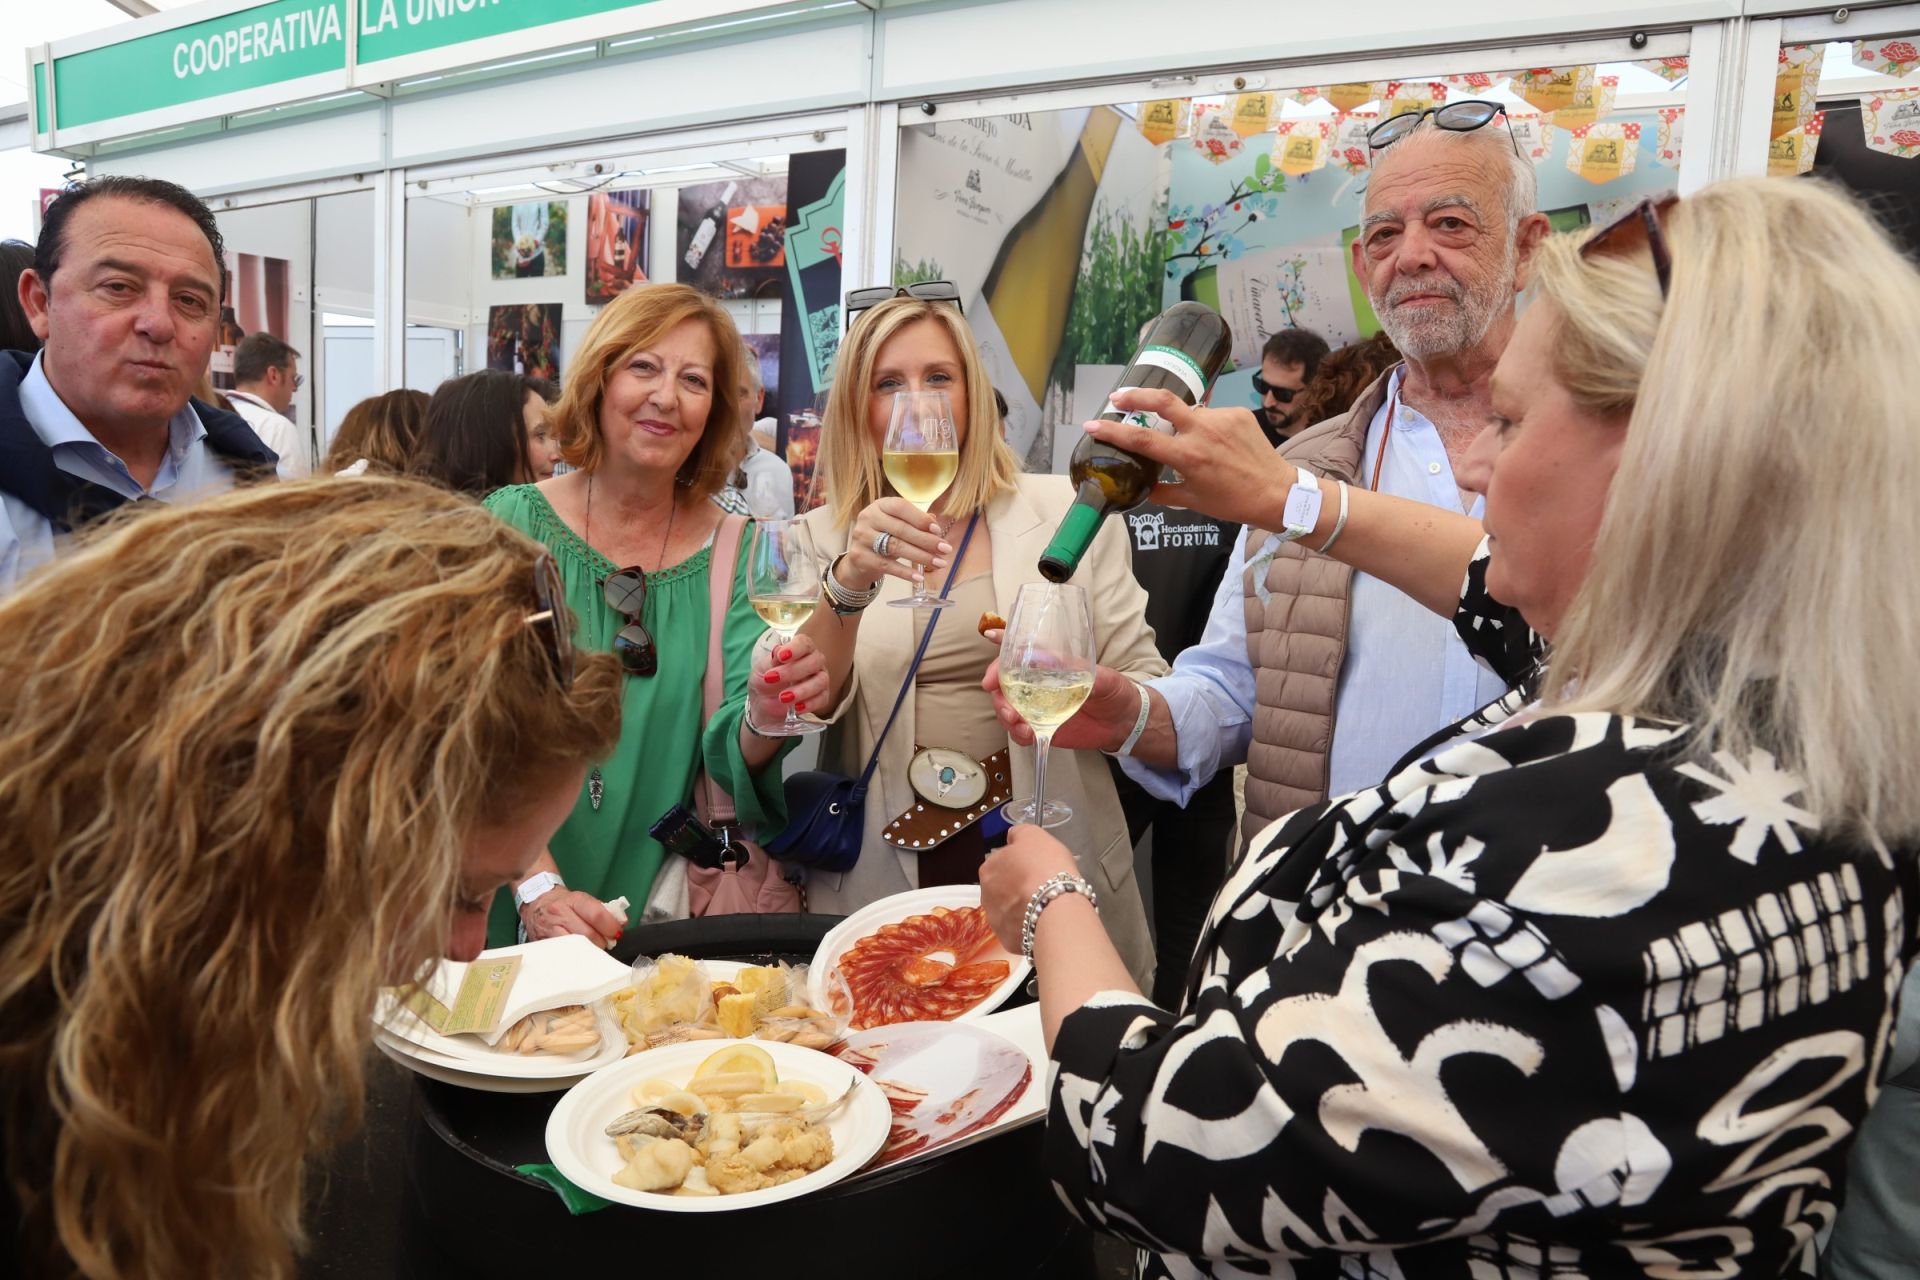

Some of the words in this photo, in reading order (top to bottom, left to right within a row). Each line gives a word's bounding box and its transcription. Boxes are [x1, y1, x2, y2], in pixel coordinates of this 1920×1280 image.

[173, 3, 342, 79] COOPERATIVA
[361, 0, 398, 36] LA
[1163, 533, 1219, 547] FORUM
